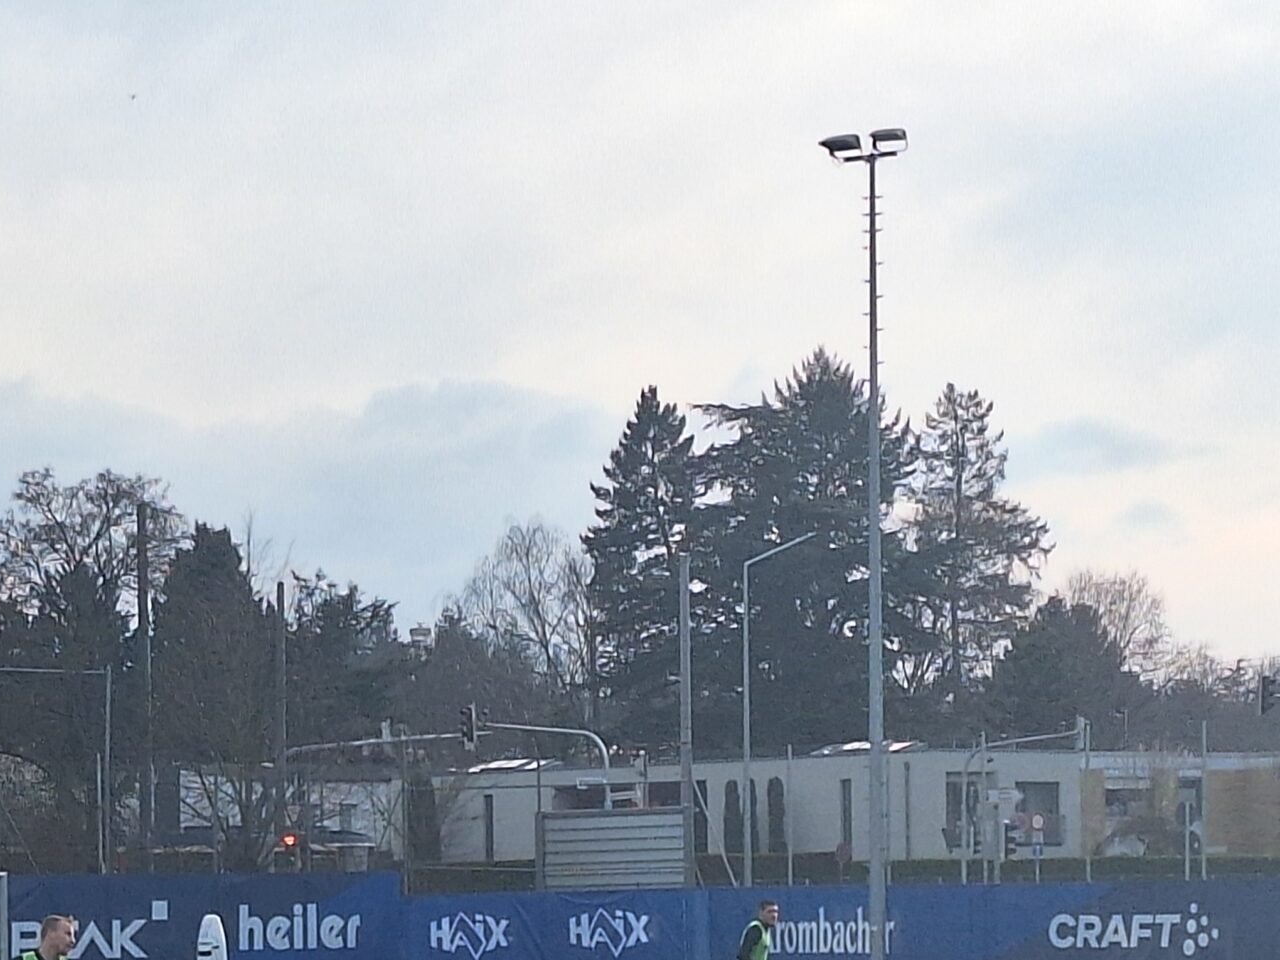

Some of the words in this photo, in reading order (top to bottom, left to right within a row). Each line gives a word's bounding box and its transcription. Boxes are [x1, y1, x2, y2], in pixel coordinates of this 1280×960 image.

[11, 919, 149, 959] PAK
[239, 903, 361, 951] heiler
[769, 906, 895, 954] rombachr
[1048, 913, 1182, 949] CRAFT
